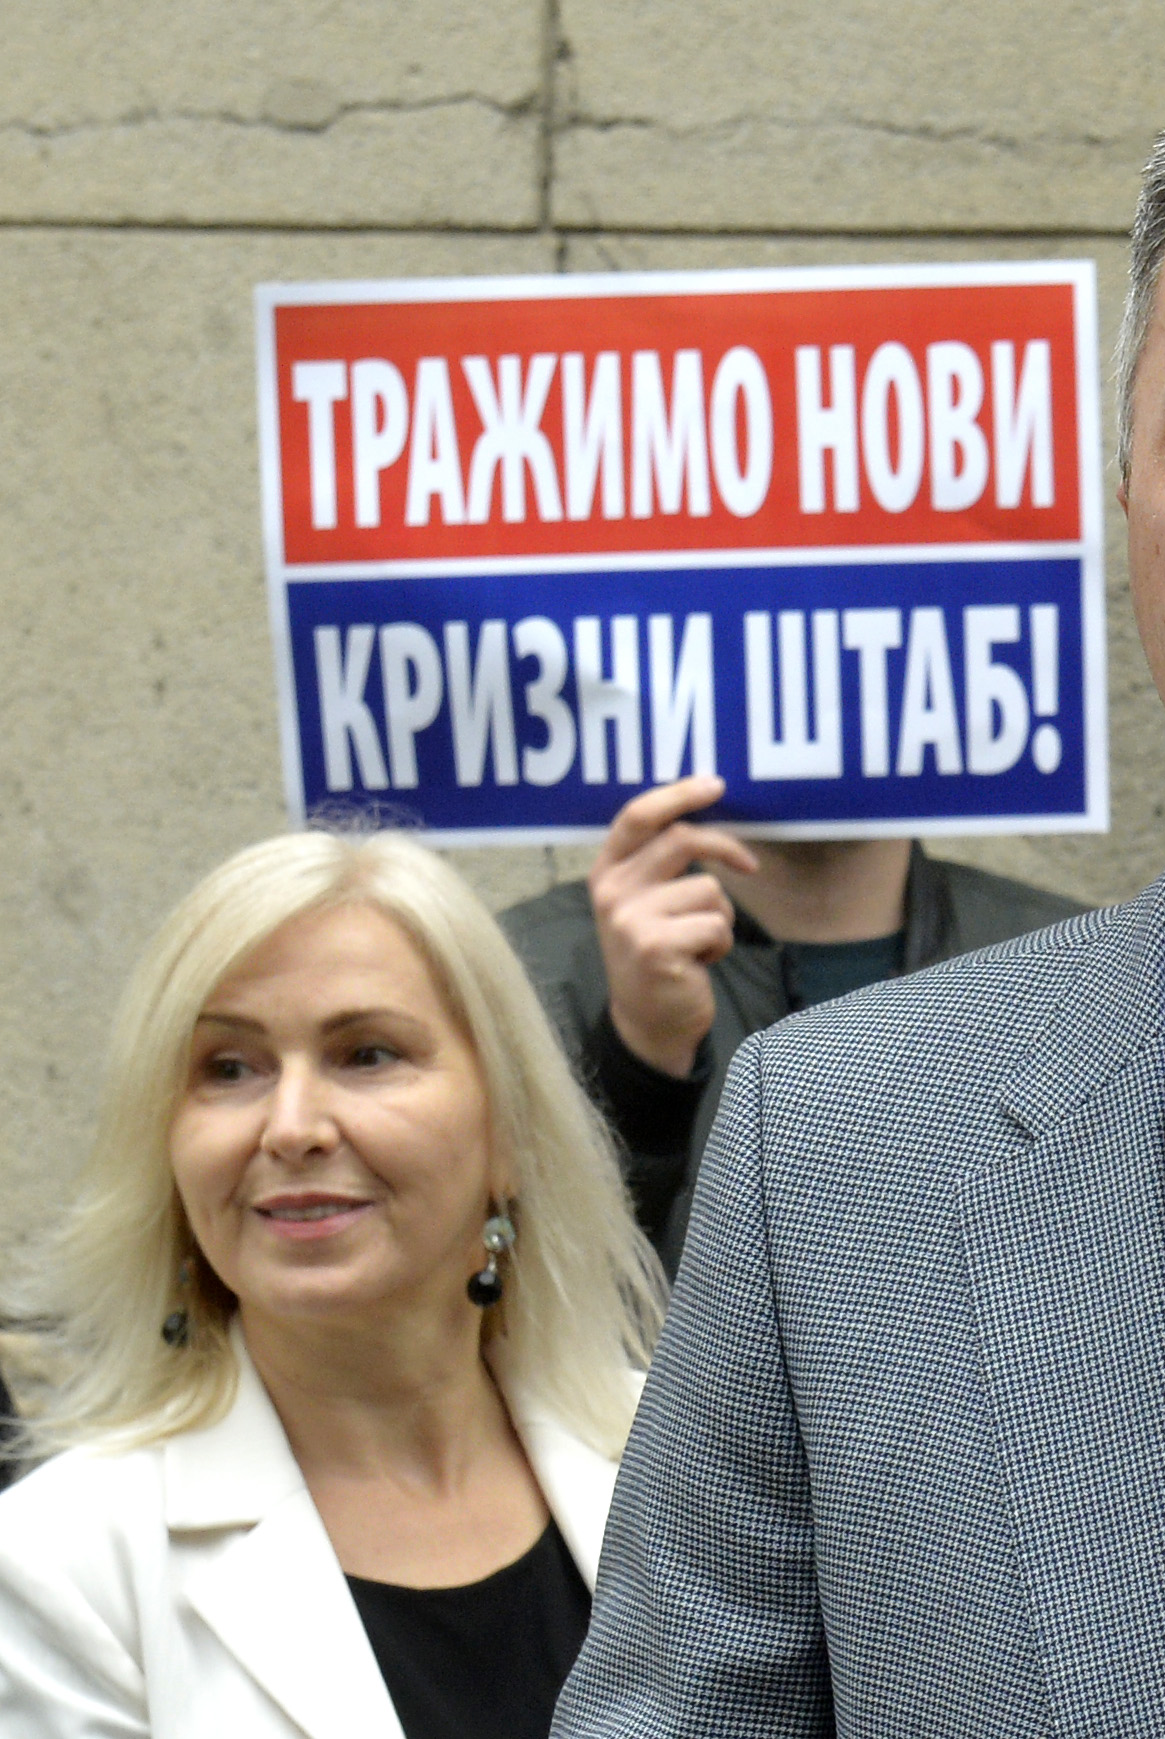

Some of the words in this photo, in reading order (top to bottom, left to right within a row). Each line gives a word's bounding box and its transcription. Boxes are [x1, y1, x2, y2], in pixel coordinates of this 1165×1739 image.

[291, 345, 774, 531] ТРАЖИМО
[794, 338, 1056, 515] НОВИ
[313, 612, 717, 791] КРИЗНИ
[743, 603, 1063, 781] ШТАБ!
